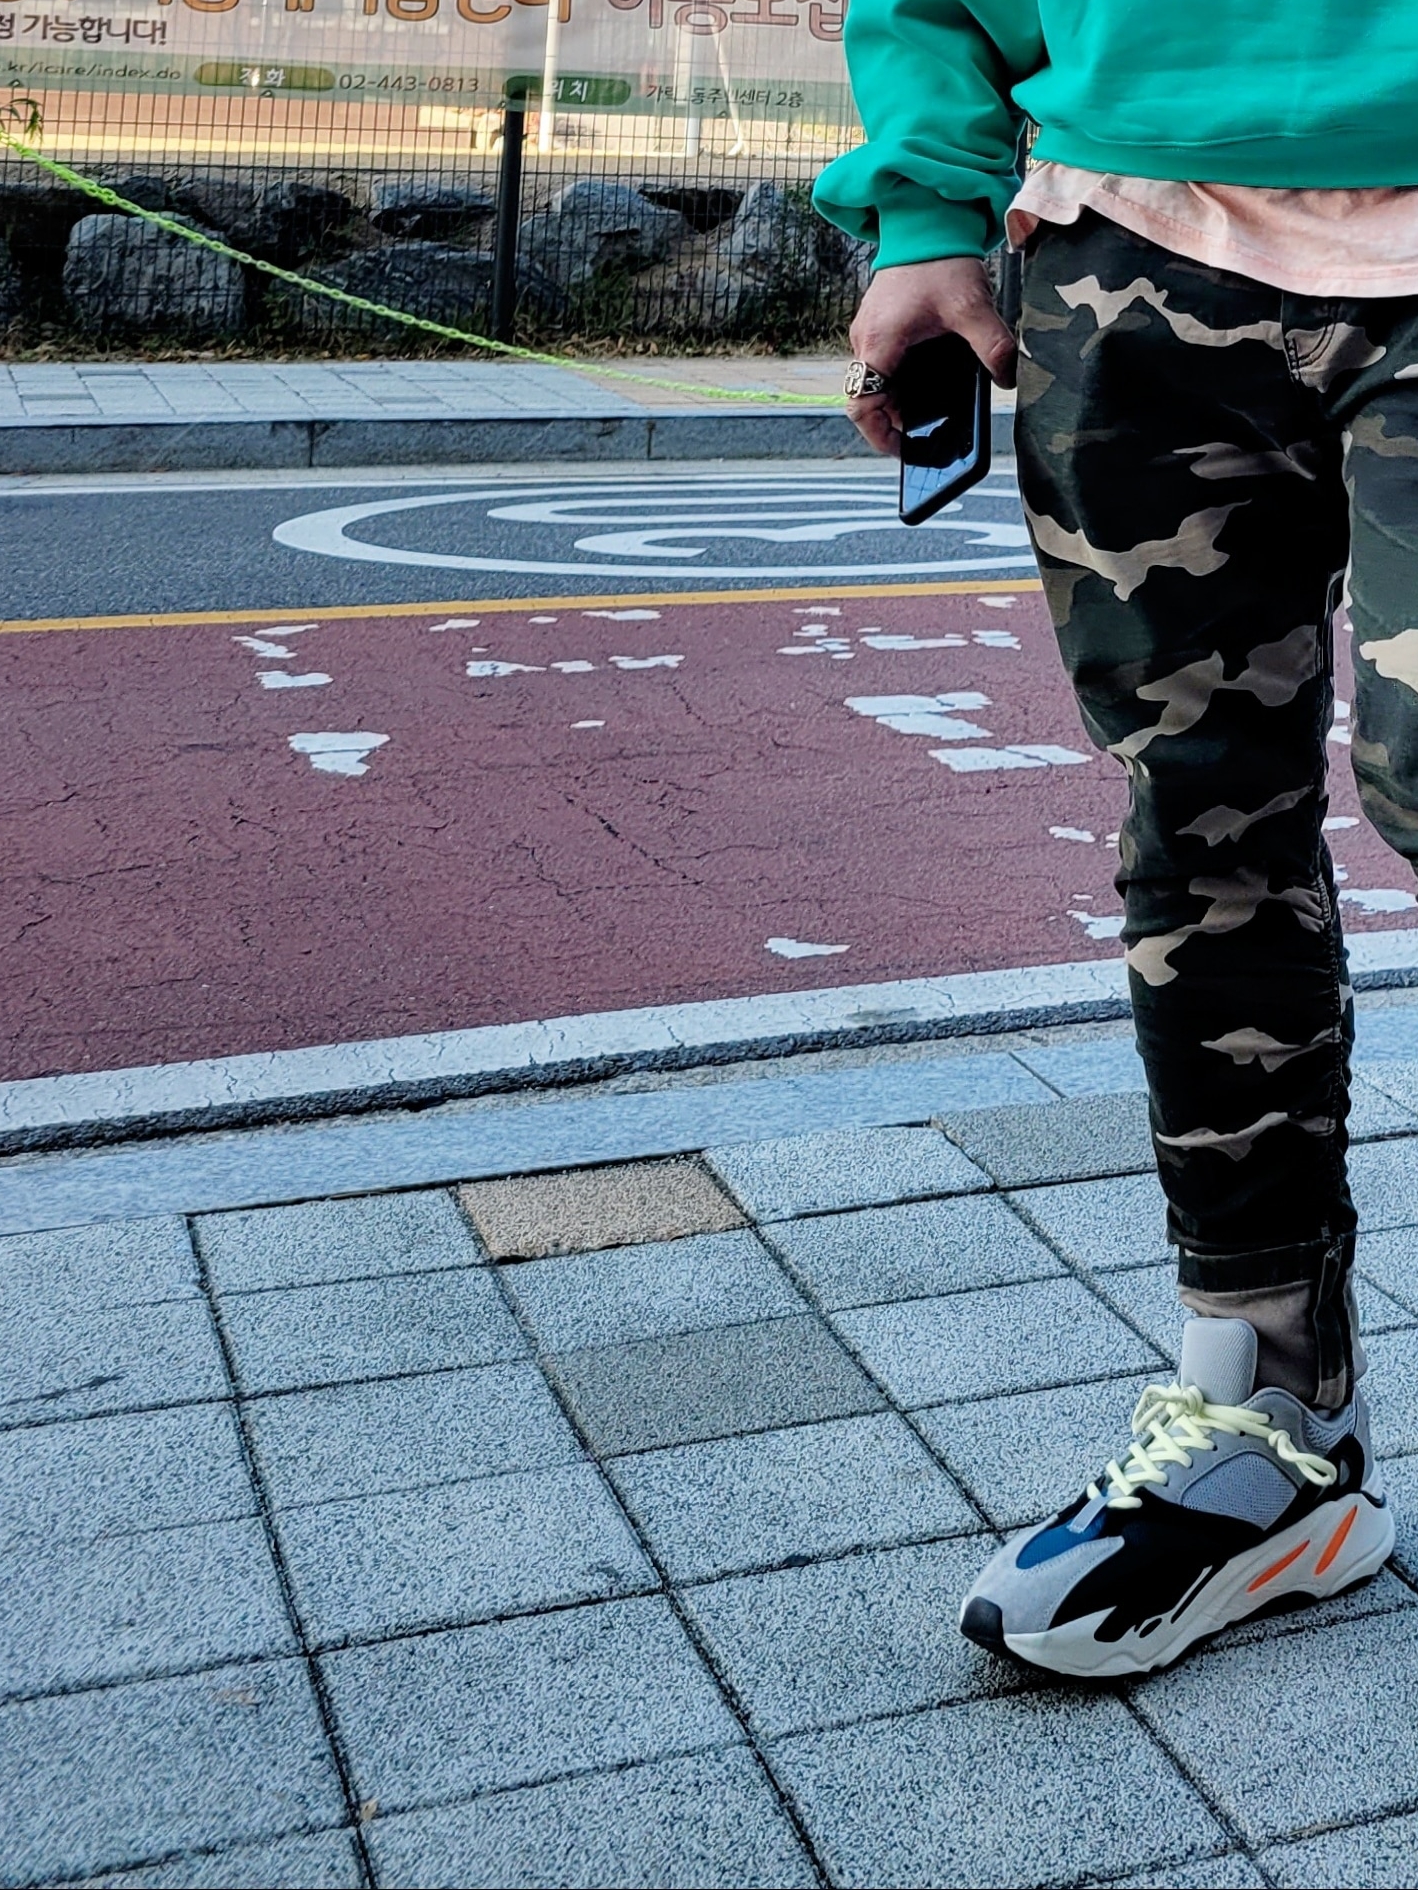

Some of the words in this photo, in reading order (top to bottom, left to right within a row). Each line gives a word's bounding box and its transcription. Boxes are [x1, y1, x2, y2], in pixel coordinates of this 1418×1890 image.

[22, 14, 168, 46] 가능합니다!
[339, 73, 480, 93] 02-443-0813
[775, 90, 805, 109] 2층
